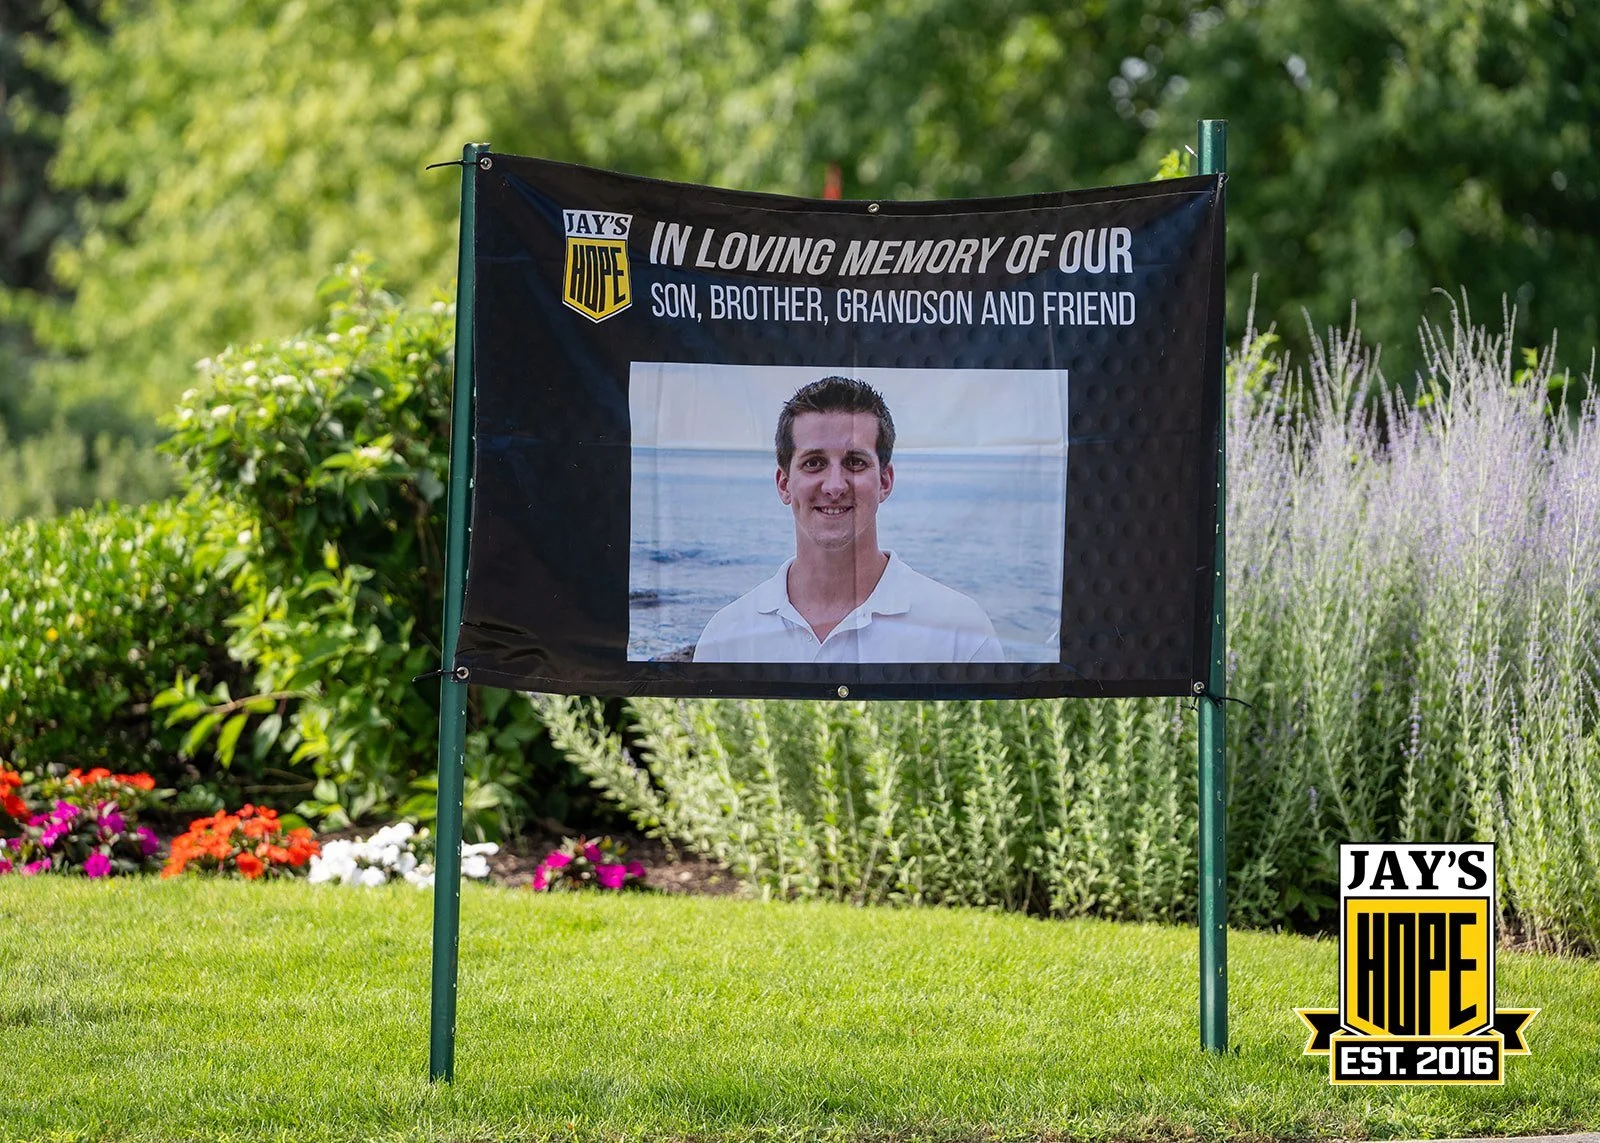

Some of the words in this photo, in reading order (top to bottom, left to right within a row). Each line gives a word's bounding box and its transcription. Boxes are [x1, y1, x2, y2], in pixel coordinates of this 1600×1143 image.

[566, 212, 629, 235] JAY'S
[649, 221, 693, 266] IN
[695, 228, 836, 276] LOVING
[838, 236, 1006, 276] MEMORY
[1005, 233, 1056, 274] OF
[1058, 227, 1133, 274] OUR
[569, 244, 626, 313] HOPE
[650, 282, 702, 323] SON,
[710, 284, 829, 326] BROTHER,
[836, 288, 973, 325] GRANDSON
[981, 291, 1035, 326] AND
[1043, 291, 1136, 326] FRIEND
